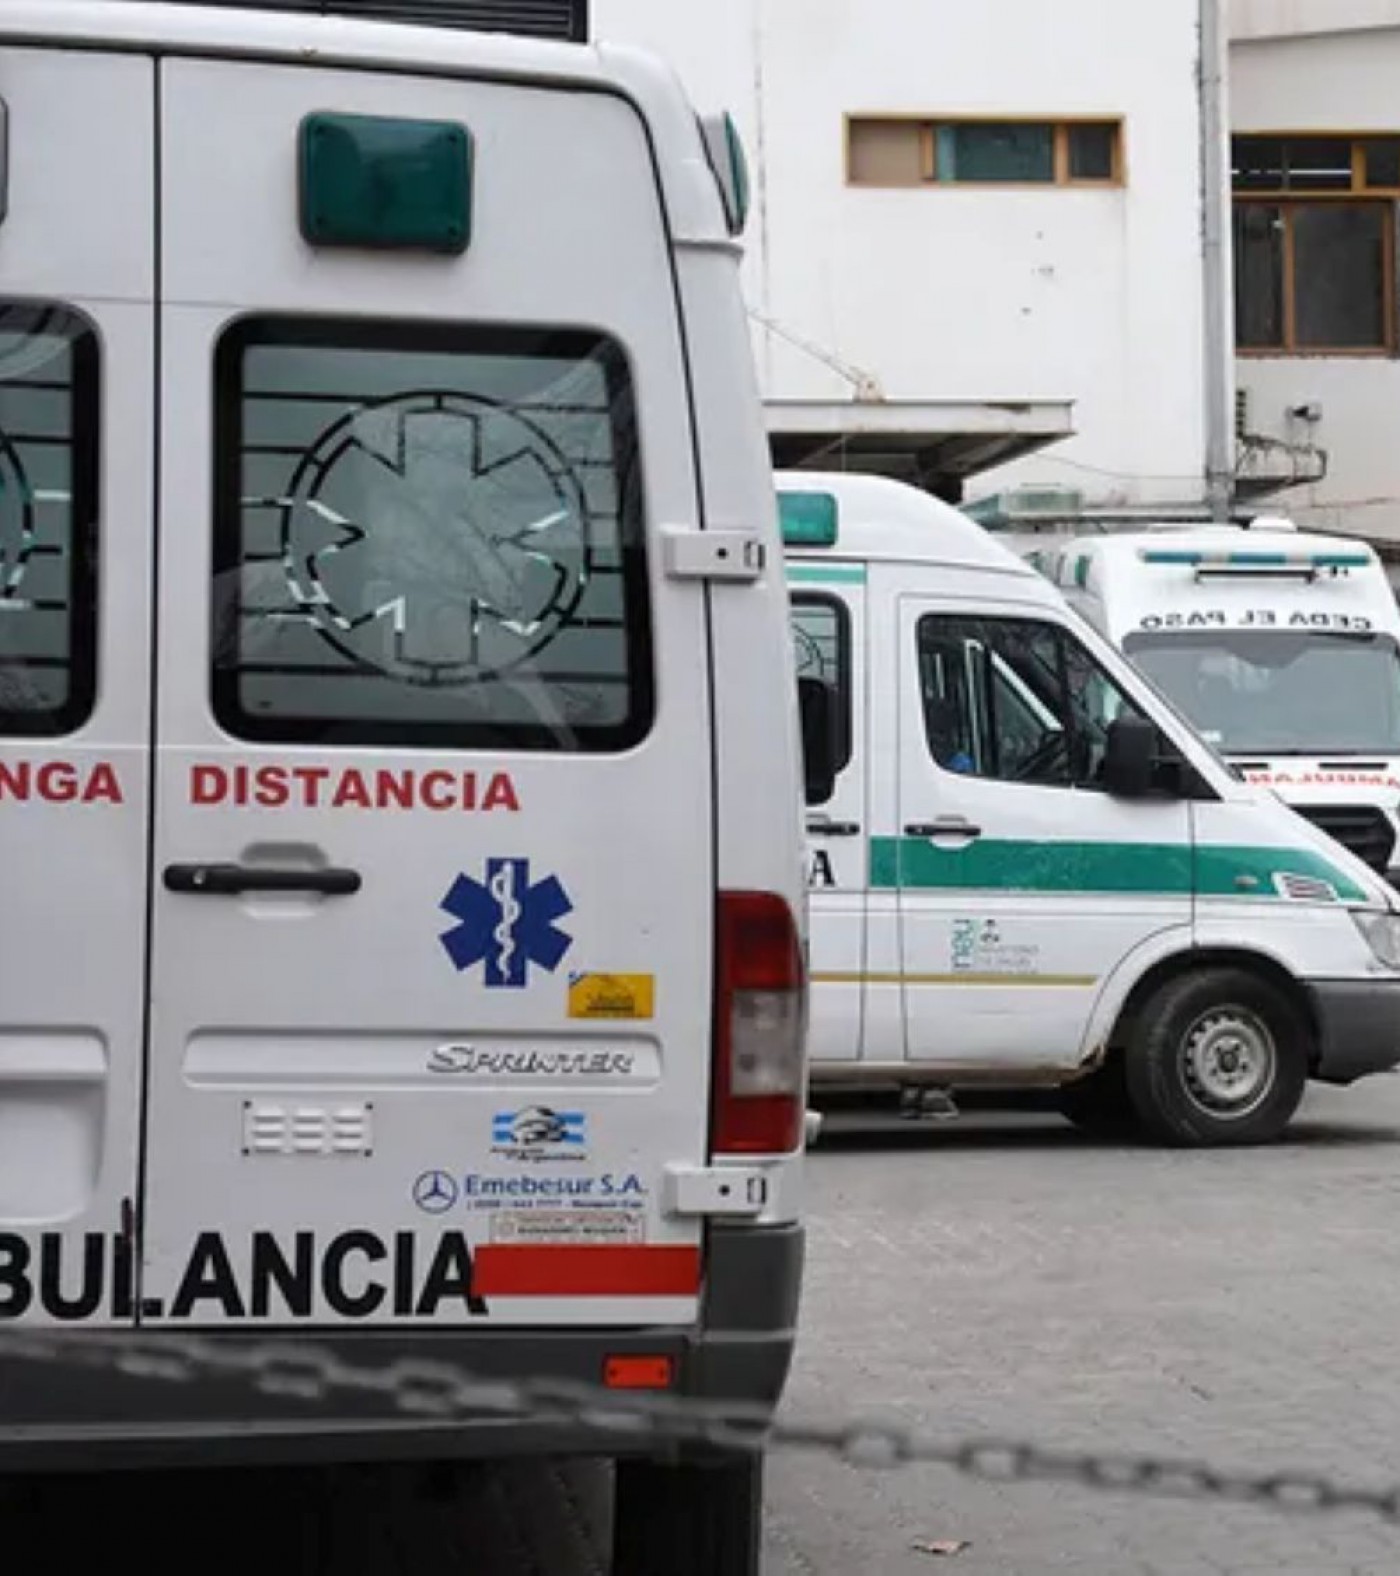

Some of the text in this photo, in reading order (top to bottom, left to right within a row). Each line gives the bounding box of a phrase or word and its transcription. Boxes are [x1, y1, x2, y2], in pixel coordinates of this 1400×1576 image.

[189, 765, 521, 813] DISTANCIA
[464, 1173, 649, 1197] Emebesur S.A.
